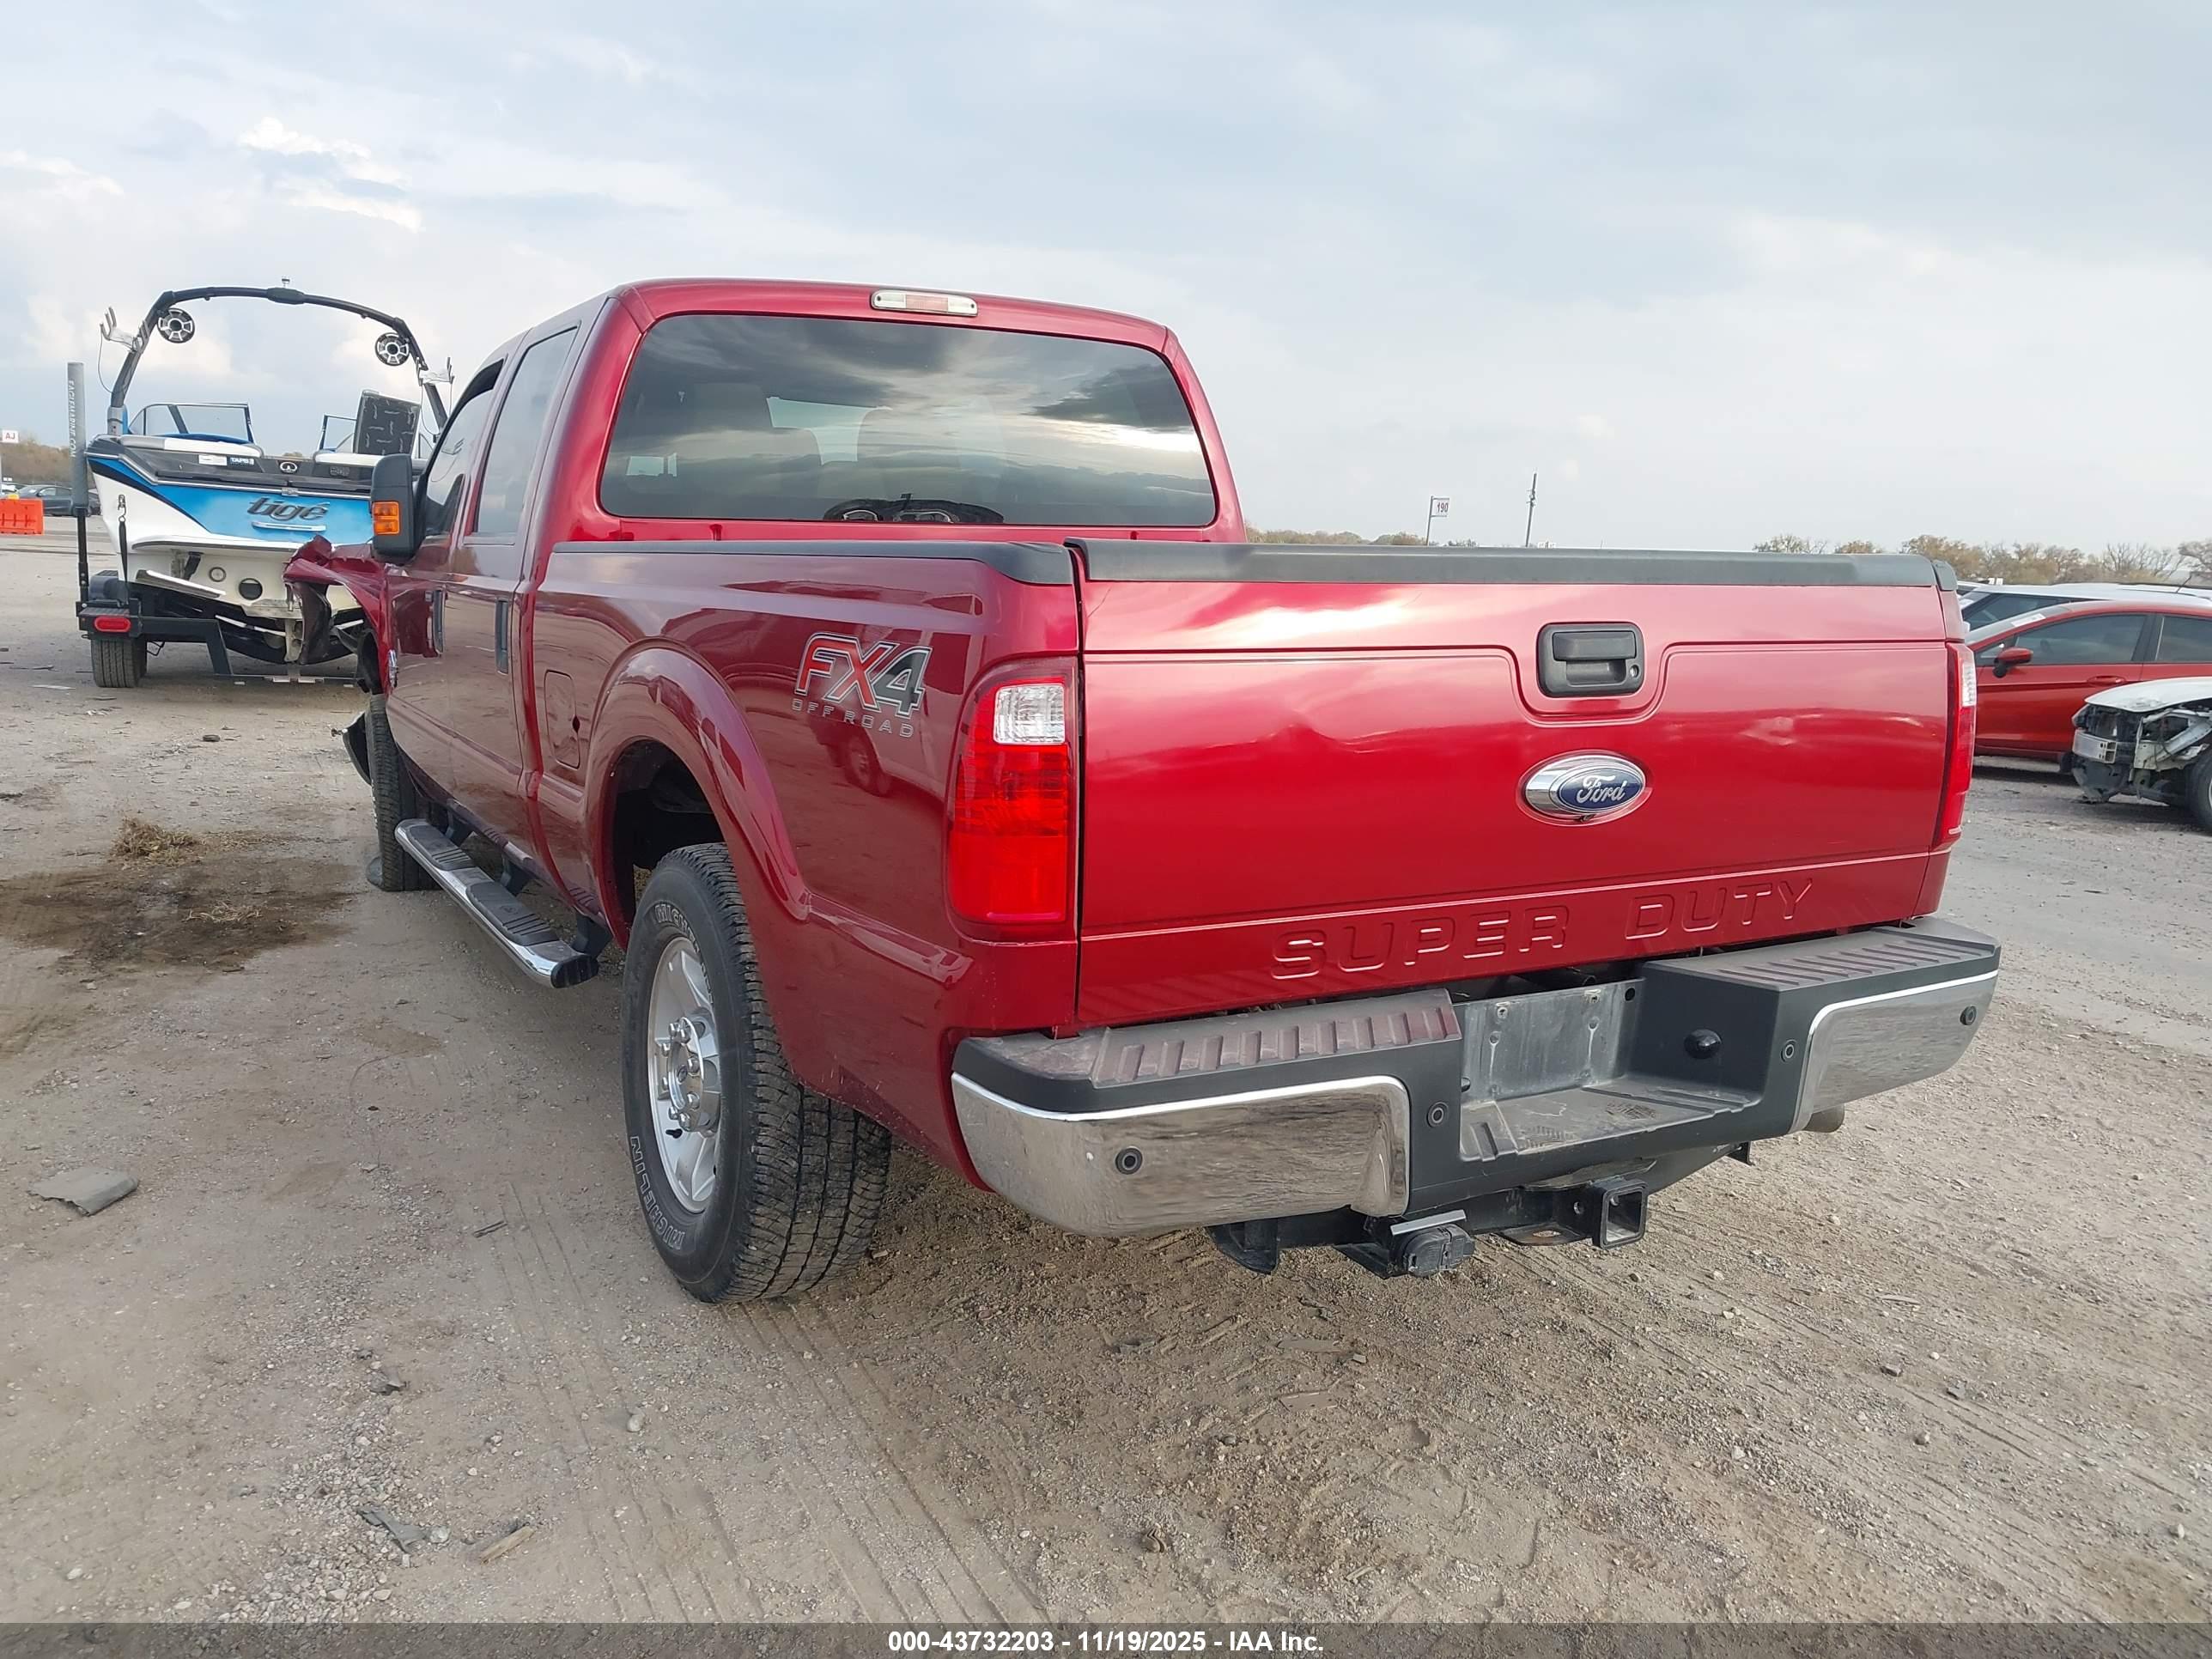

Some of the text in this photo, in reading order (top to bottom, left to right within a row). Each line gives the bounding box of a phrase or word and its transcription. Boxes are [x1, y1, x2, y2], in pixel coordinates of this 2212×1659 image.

[1437, 501, 1449, 513] 190
[794, 631, 933, 720] FX4
[792, 698, 914, 738] OFF ROAD
[1576, 775, 1627, 804] Ford
[1271, 878, 1814, 981] SUPER DUTY
[630, 1135, 686, 1250] MICHELIN
